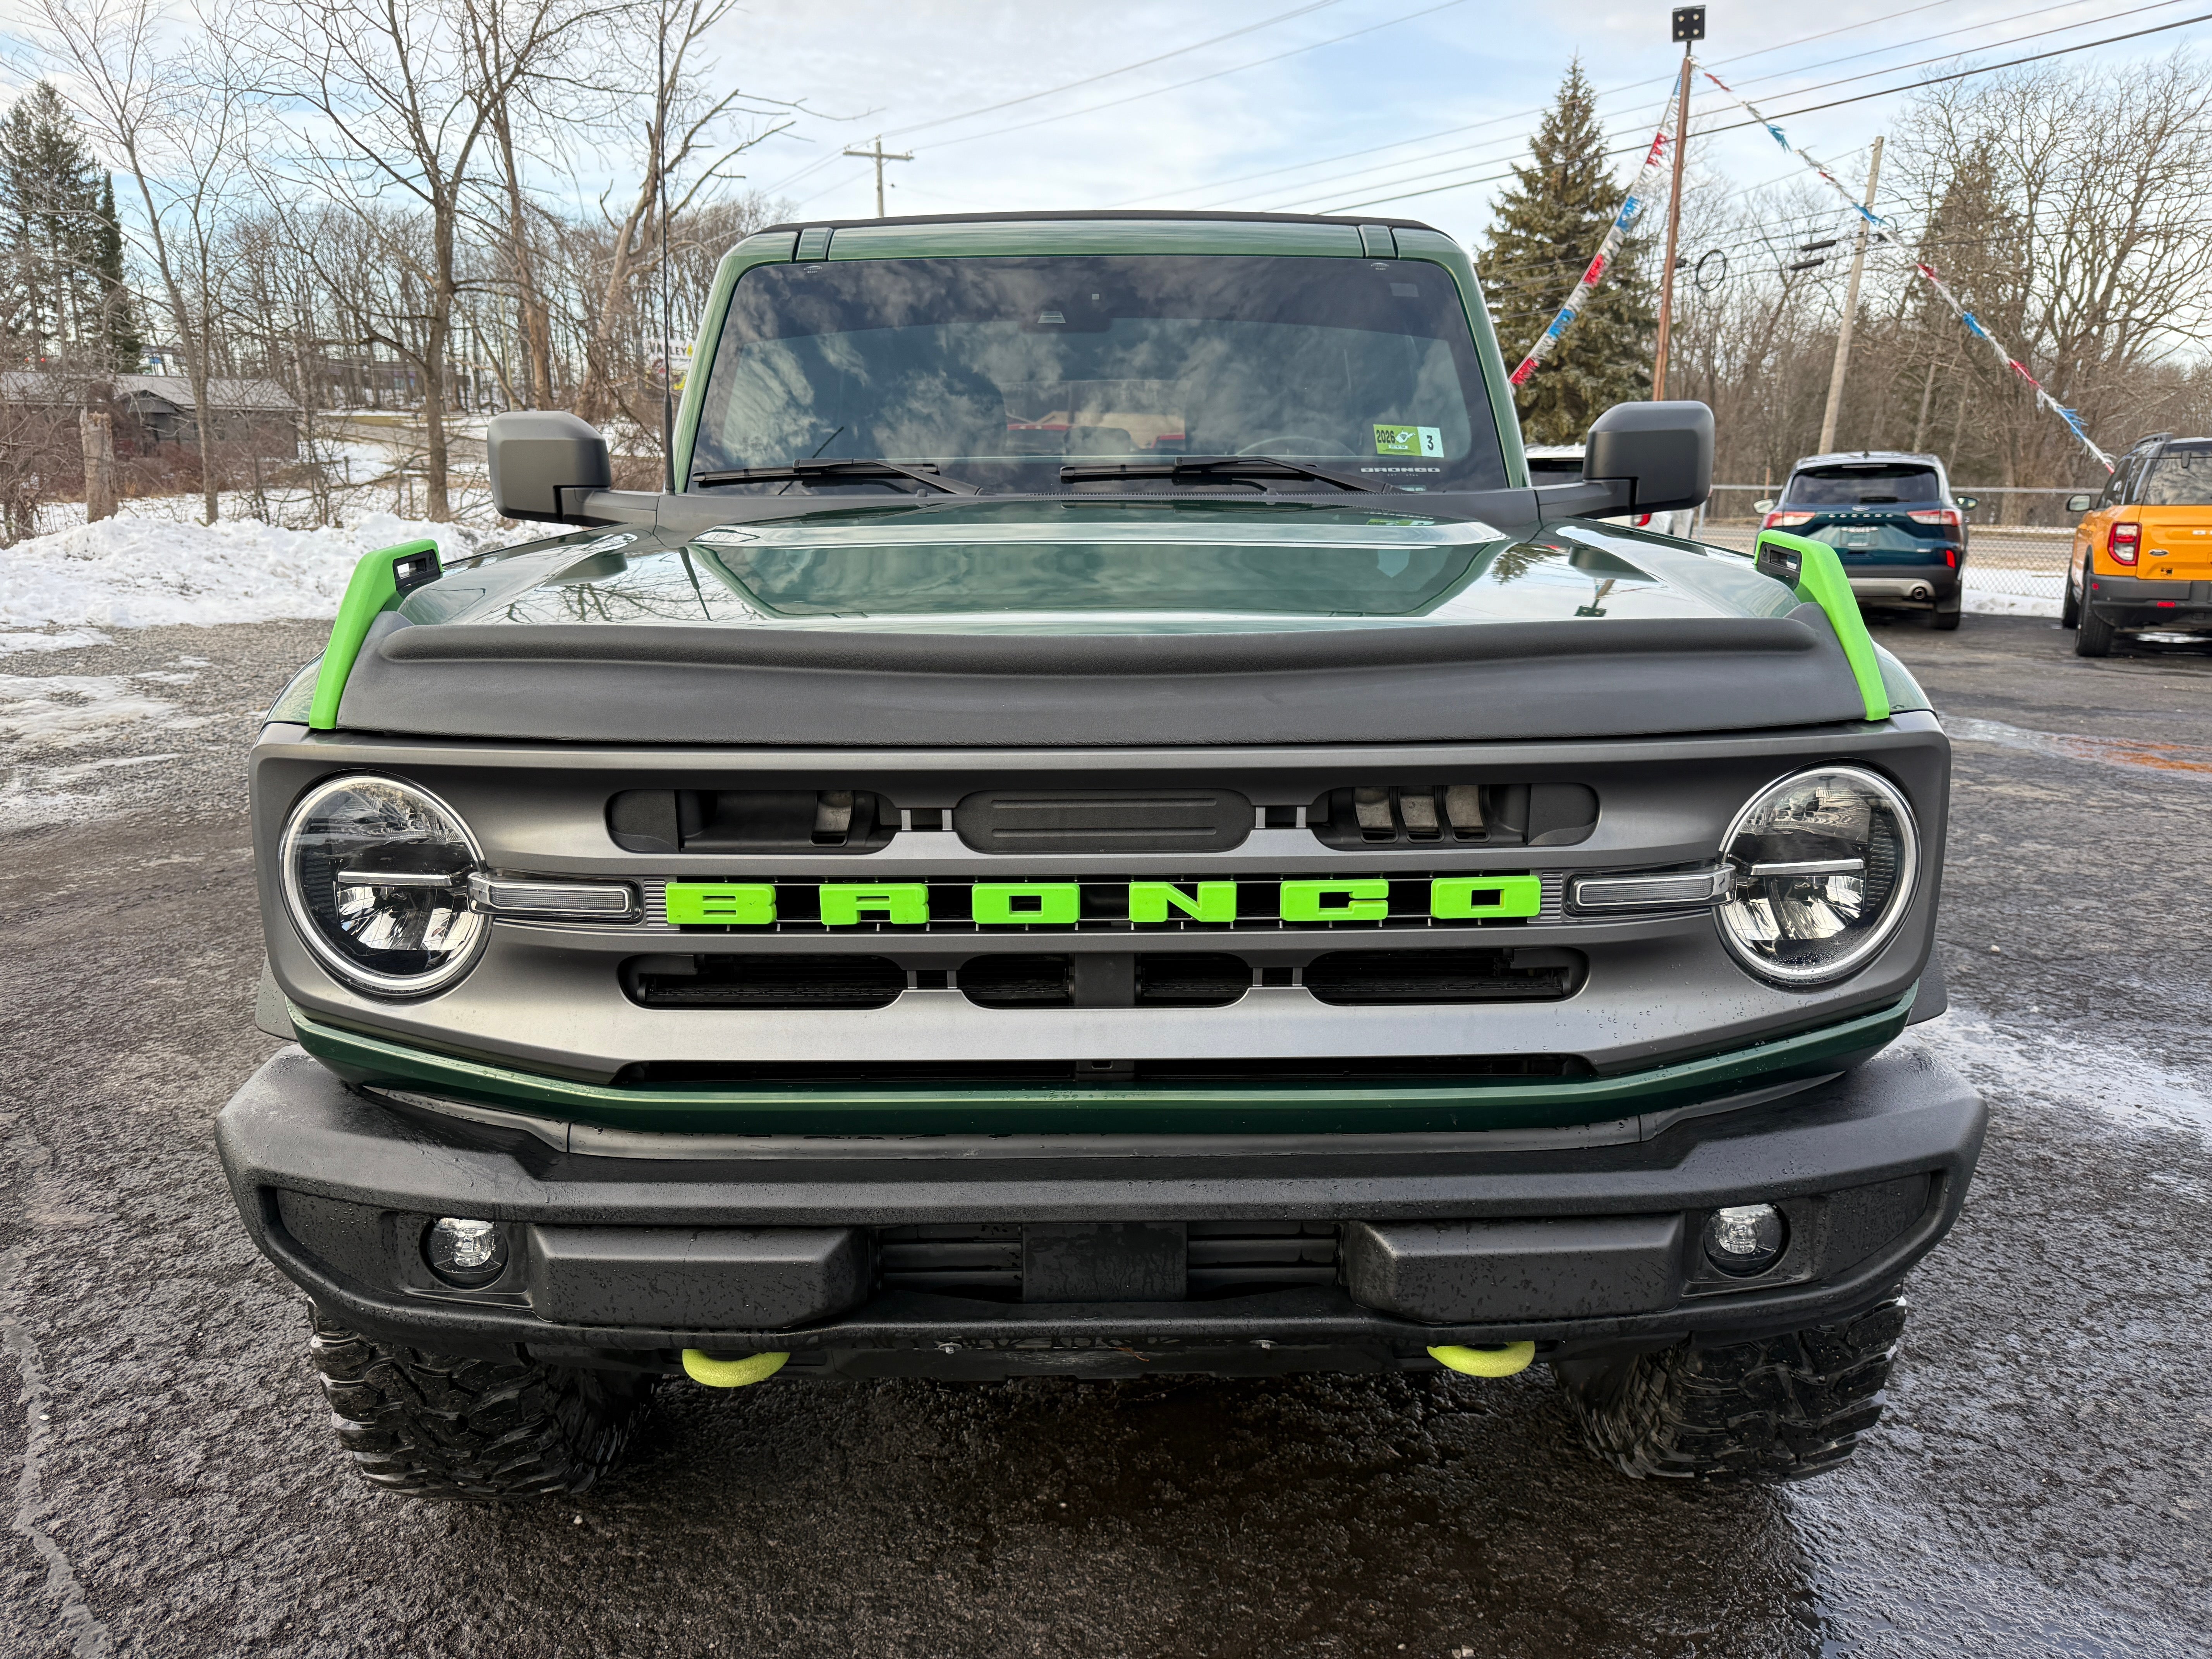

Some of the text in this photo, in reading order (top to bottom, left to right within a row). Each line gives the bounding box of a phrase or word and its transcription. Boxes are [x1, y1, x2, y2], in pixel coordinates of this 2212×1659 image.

[1376, 429, 1395, 444] 2026
[1426, 435, 1434, 451] 3
[666, 876, 1541, 926] BRONCO
